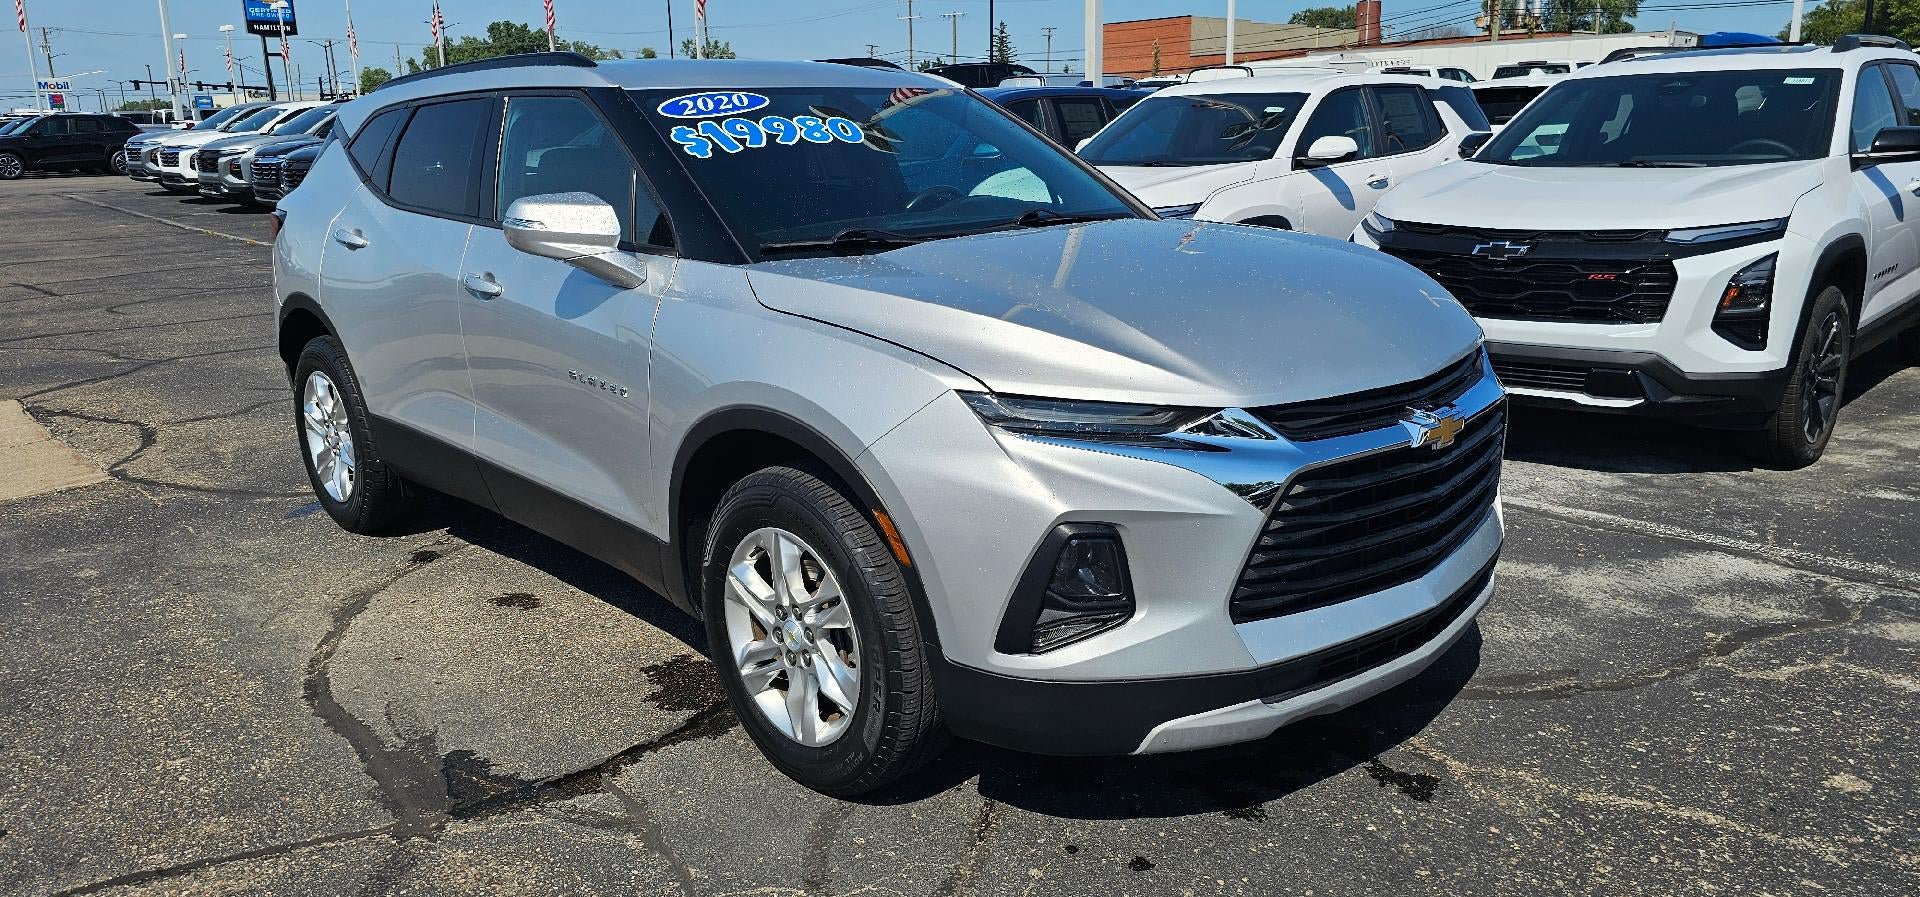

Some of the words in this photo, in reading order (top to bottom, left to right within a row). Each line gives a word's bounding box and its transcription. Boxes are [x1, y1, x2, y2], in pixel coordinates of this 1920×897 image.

[37, 81, 70, 90] Mobil
[676, 93, 750, 116] 2020
[670, 115, 865, 159] $19980
[1586, 273, 1617, 281] RS
